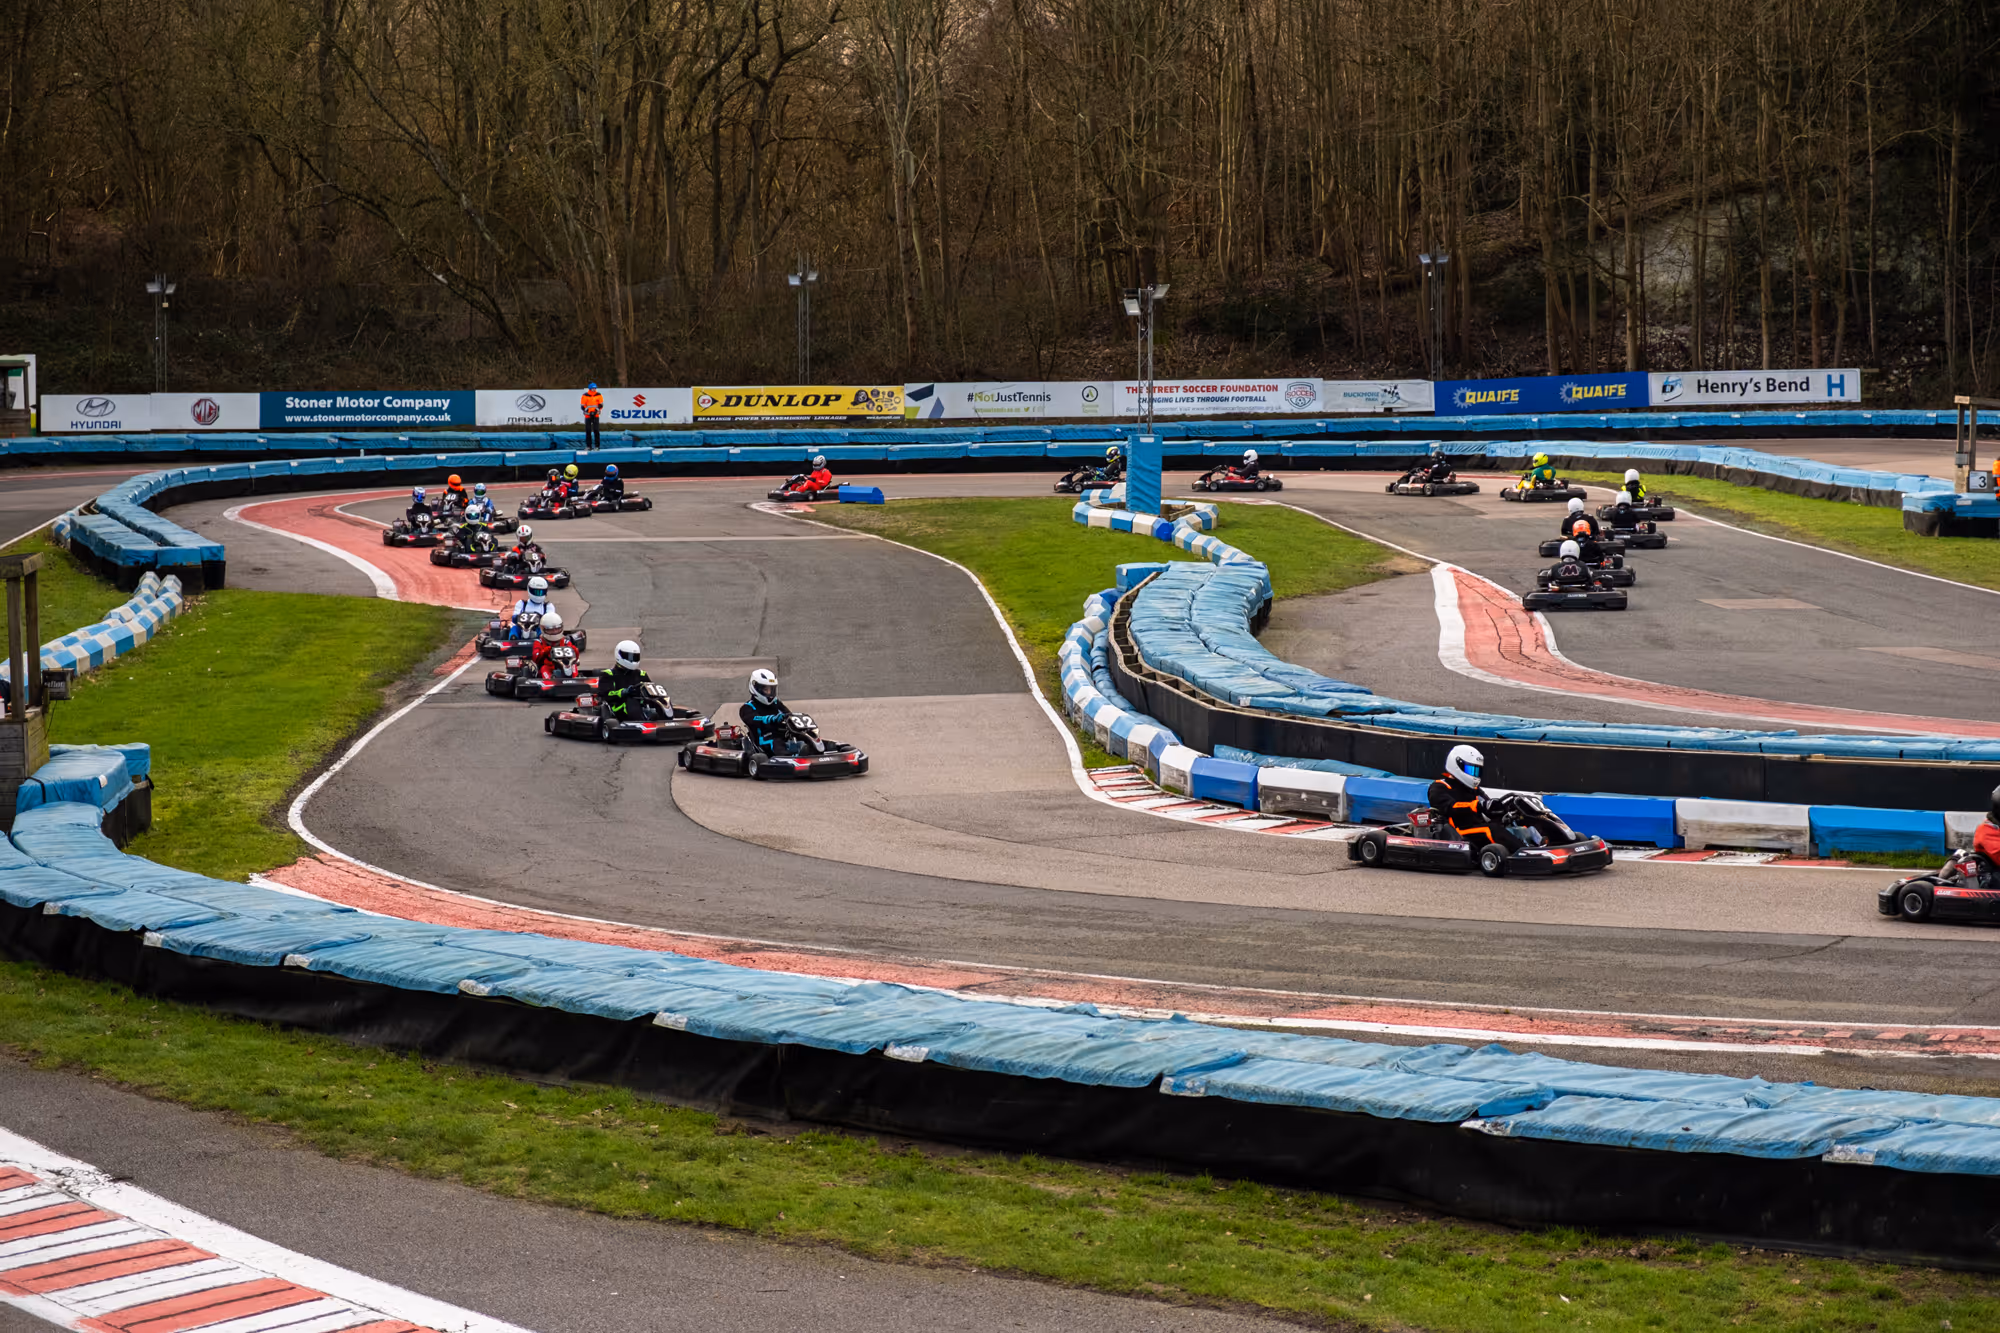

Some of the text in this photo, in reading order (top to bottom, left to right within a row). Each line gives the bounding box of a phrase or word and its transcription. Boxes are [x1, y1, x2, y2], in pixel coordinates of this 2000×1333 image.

[1125, 386, 1143, 394] THE
[1220, 384, 1279, 392] FOUNDATION
[1766, 377, 1810, 392] Bend
[1827, 374, 1845, 397] H
[1465, 389, 1520, 404] QUAIFE
[1571, 384, 1627, 399] QUAIFE
[285, 396, 451, 410] Stoner Motor Company
[720, 394, 843, 407] DUNLOP
[193, 399, 219, 424] MG
[285, 413, 451, 423] www.stonermotorcompany.co.uk
[611, 410, 667, 419] SUZUKI
[70, 421, 122, 429] HYUNDAI
[1978, 475, 1987, 488] 3
[417, 514, 430, 522] 39
[520, 613, 538, 622] 37
[554, 647, 574, 657] 53
[646, 684, 668, 697] 16
[791, 716, 817, 729] 32
